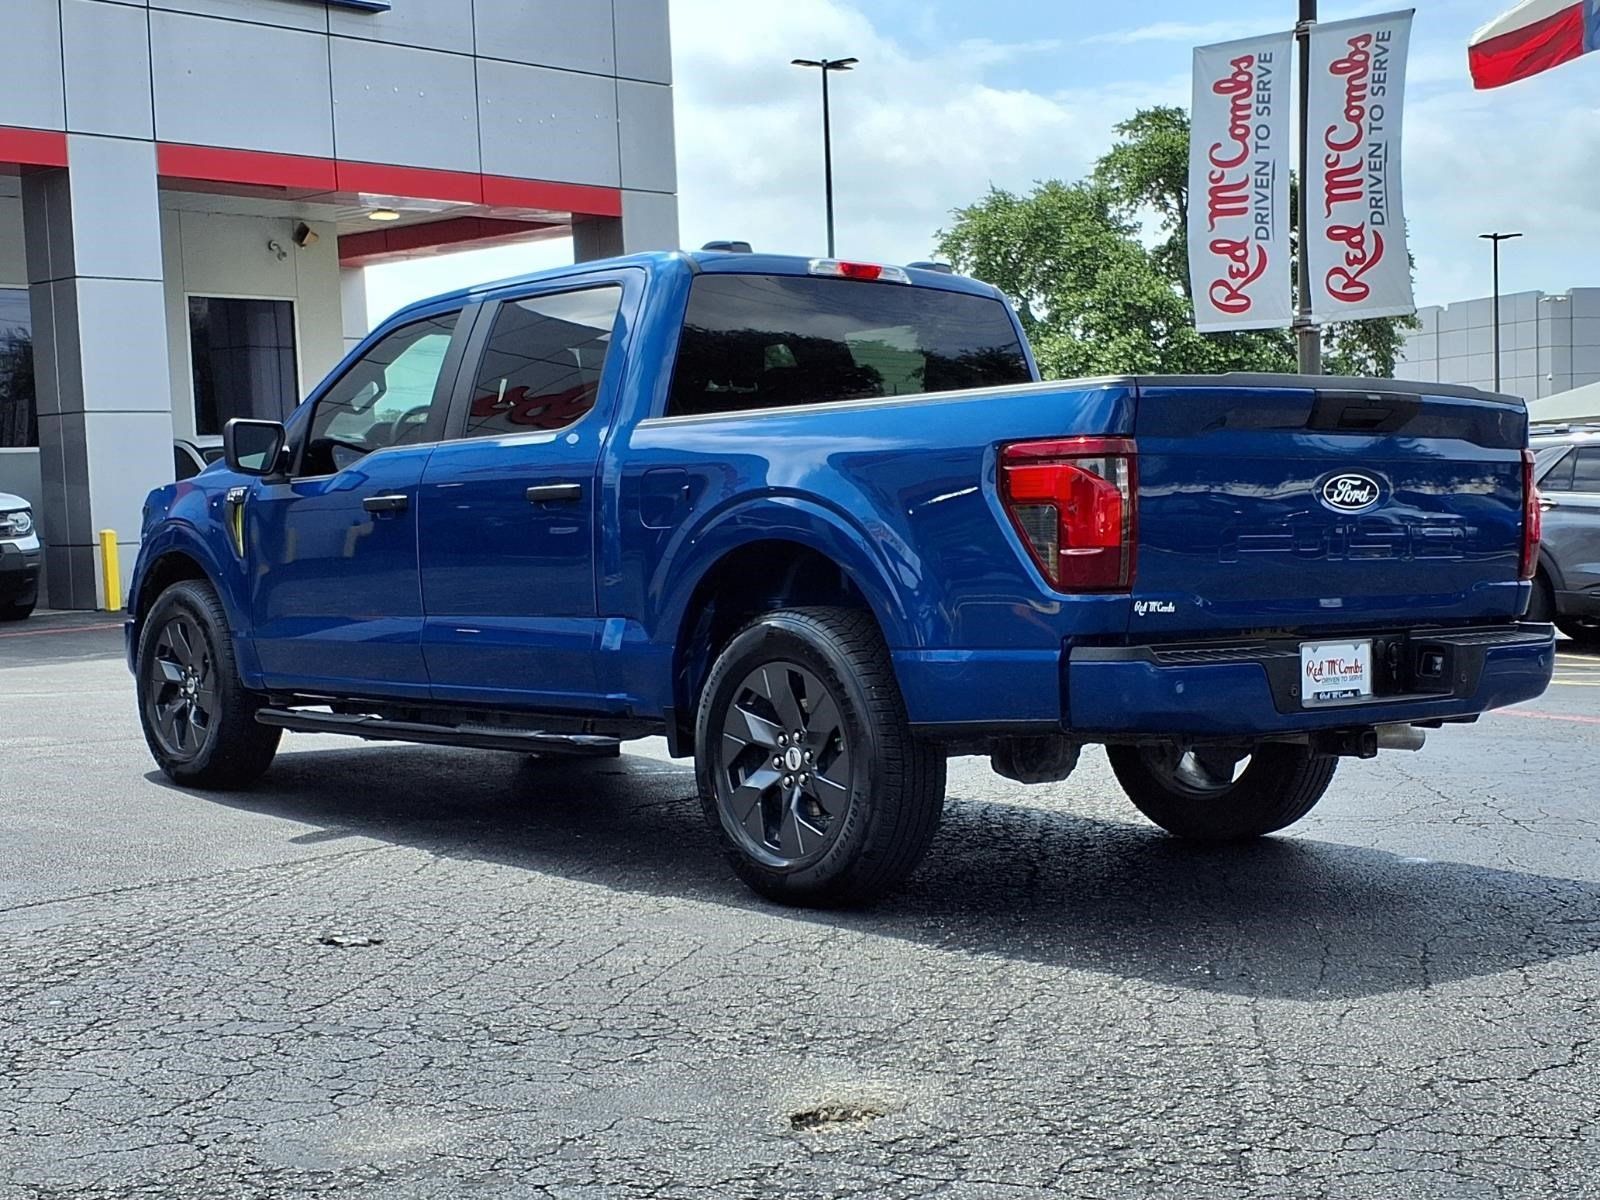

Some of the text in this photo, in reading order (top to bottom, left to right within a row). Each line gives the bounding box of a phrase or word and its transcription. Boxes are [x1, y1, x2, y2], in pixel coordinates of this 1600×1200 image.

[1207, 53, 1268, 314] Red McCombs
[1254, 52, 1273, 241] DRIVEN TO SERVE
[1324, 32, 1384, 303] Red McCombs
[1368, 30, 1392, 227] DRIVEN TO SERVE
[1330, 478, 1371, 503] Ford
[1134, 600, 1148, 616] Red
[1306, 658, 1363, 683] Red McCombs
[831, 791, 862, 862] TERRITORY
